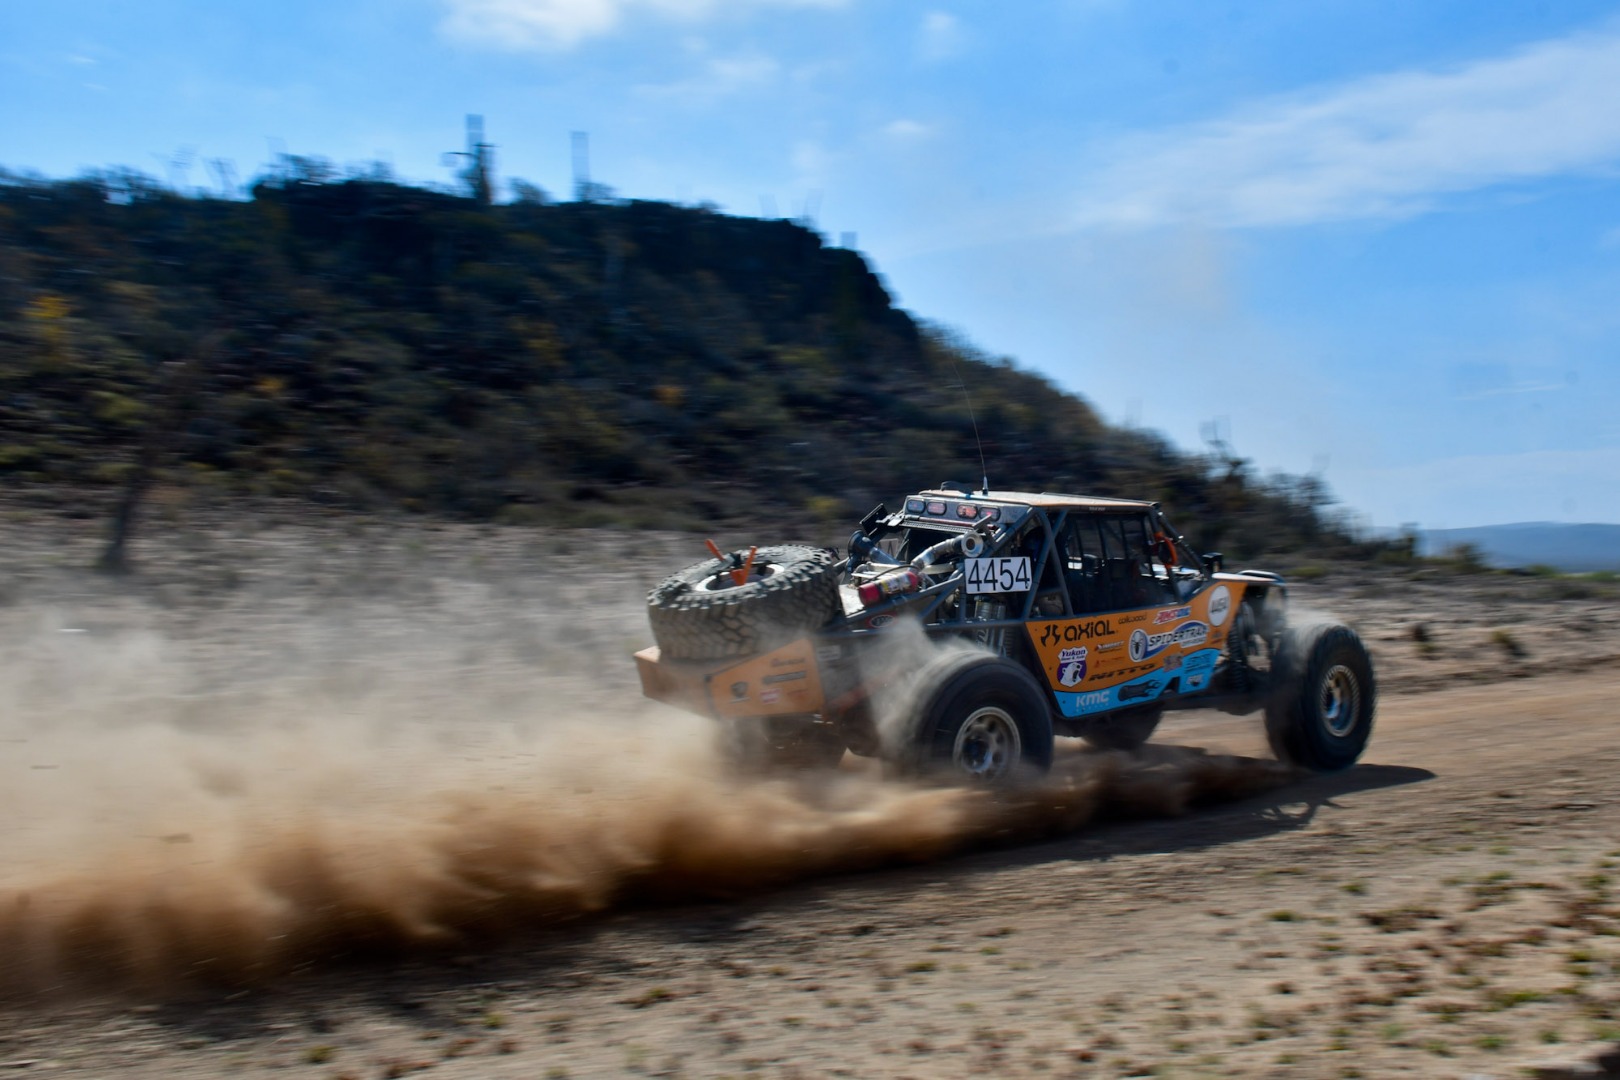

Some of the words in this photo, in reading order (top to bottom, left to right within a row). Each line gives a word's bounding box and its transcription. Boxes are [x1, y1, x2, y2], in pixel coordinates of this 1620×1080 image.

[967, 558, 1030, 591] 4454
[1061, 648, 1086, 658] Yukon
[1076, 690, 1111, 707] KMC
